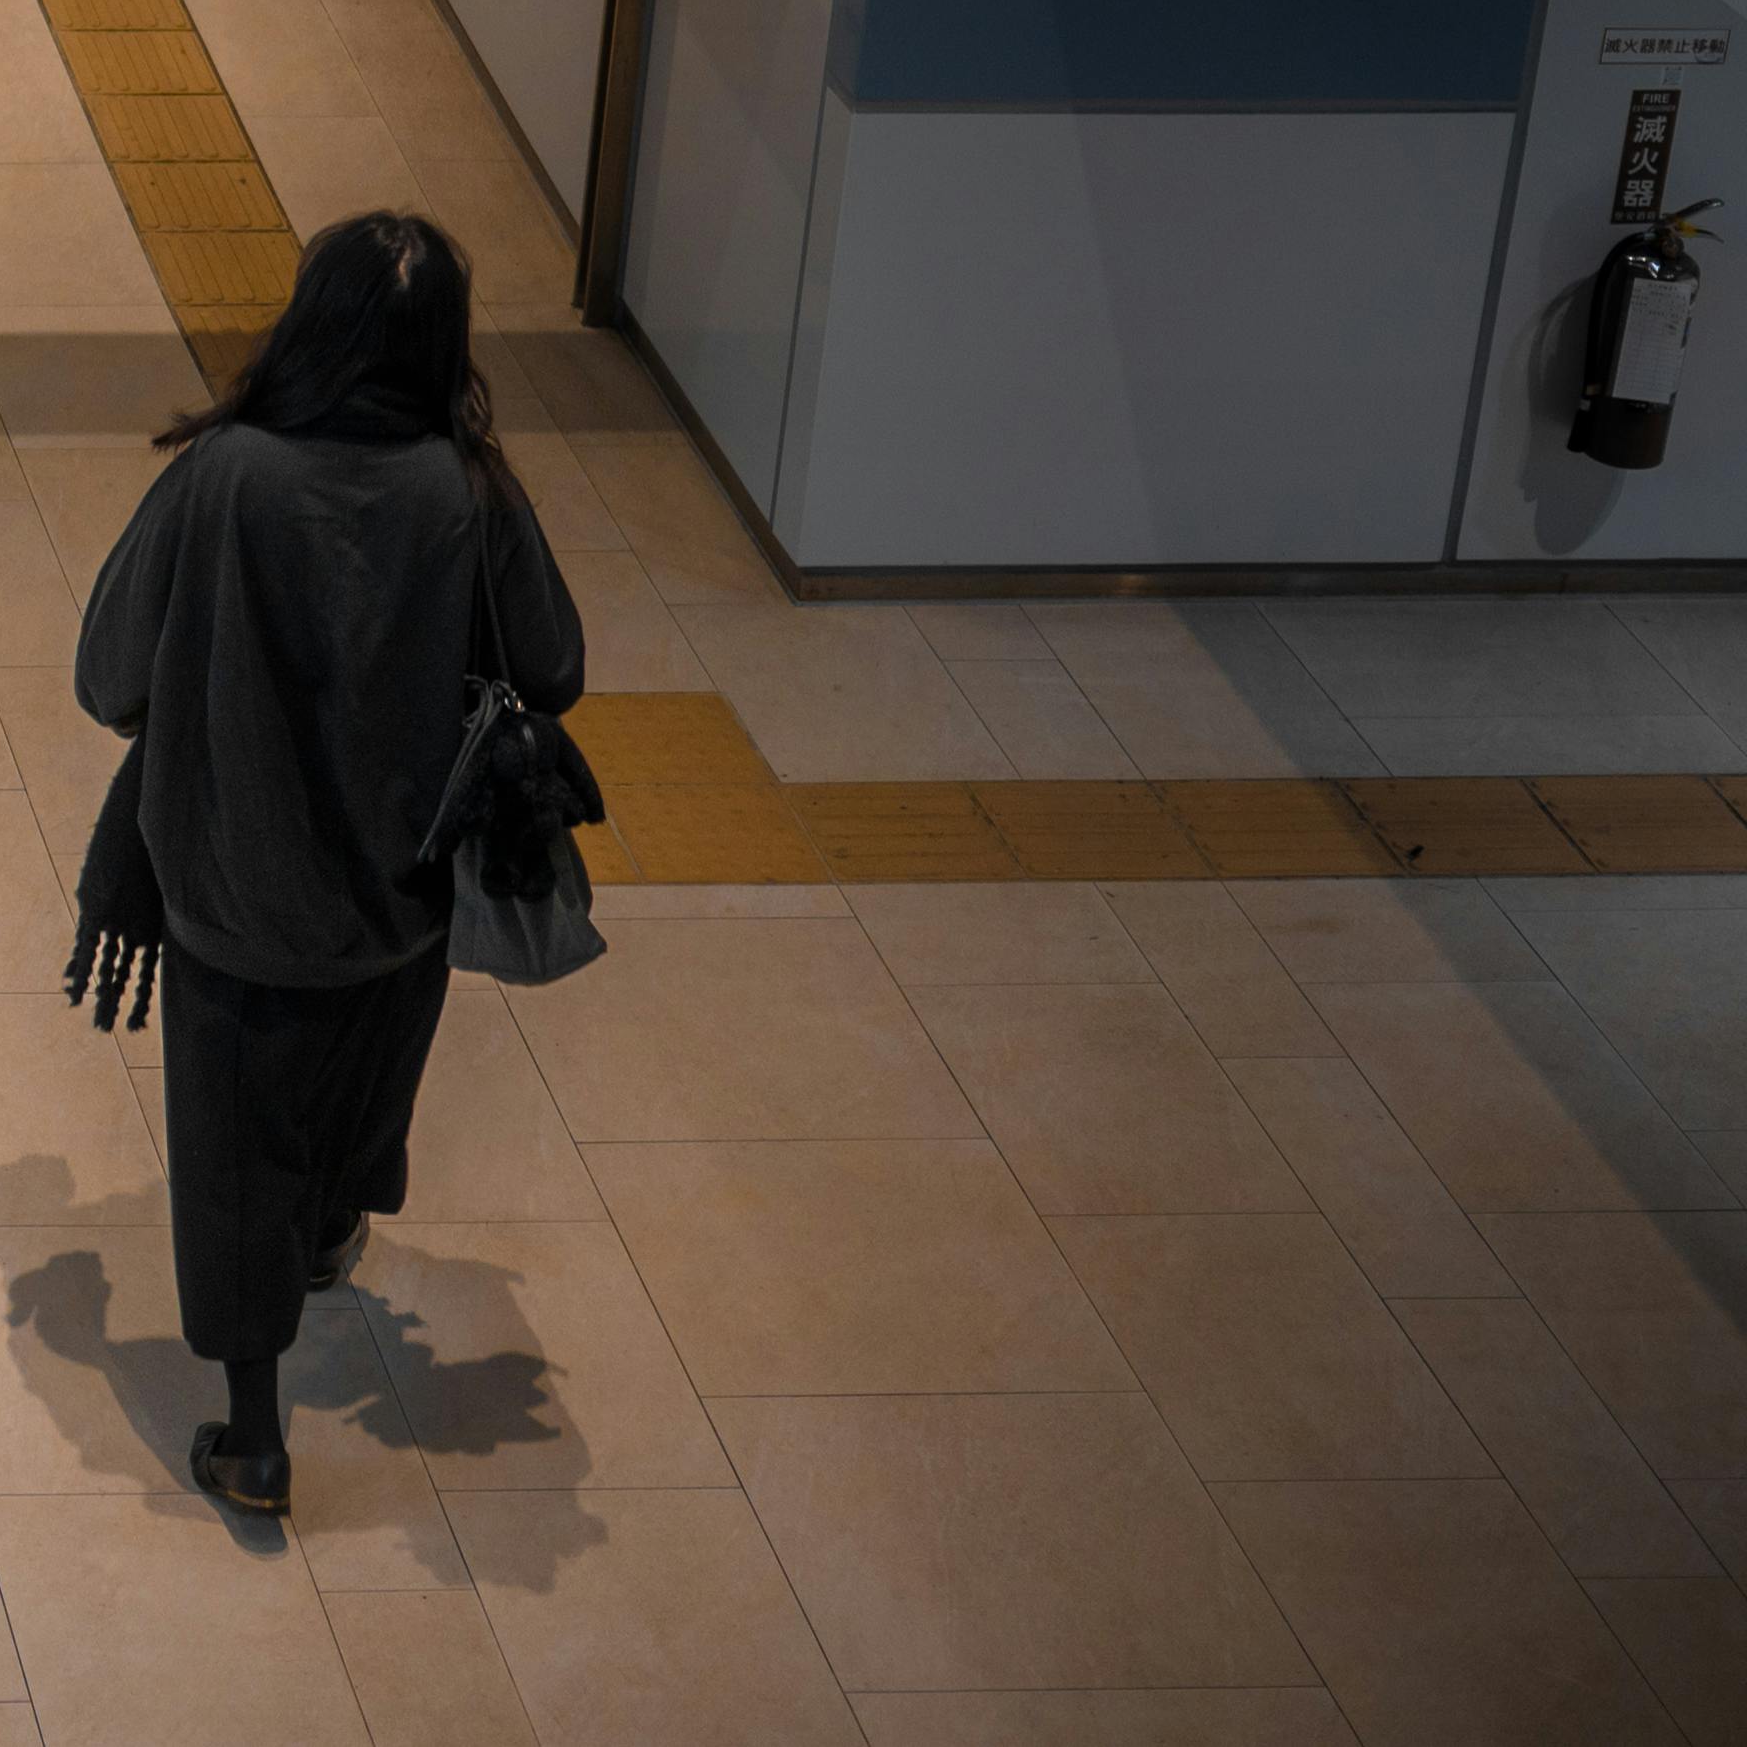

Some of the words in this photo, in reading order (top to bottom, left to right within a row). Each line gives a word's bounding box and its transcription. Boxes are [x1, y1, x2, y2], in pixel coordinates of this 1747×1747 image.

[1605, 38, 1725, 54] 滅火器禁止移動
[1643, 93, 1669, 104] FIRE
[1623, 115, 1667, 207] 滅火器
